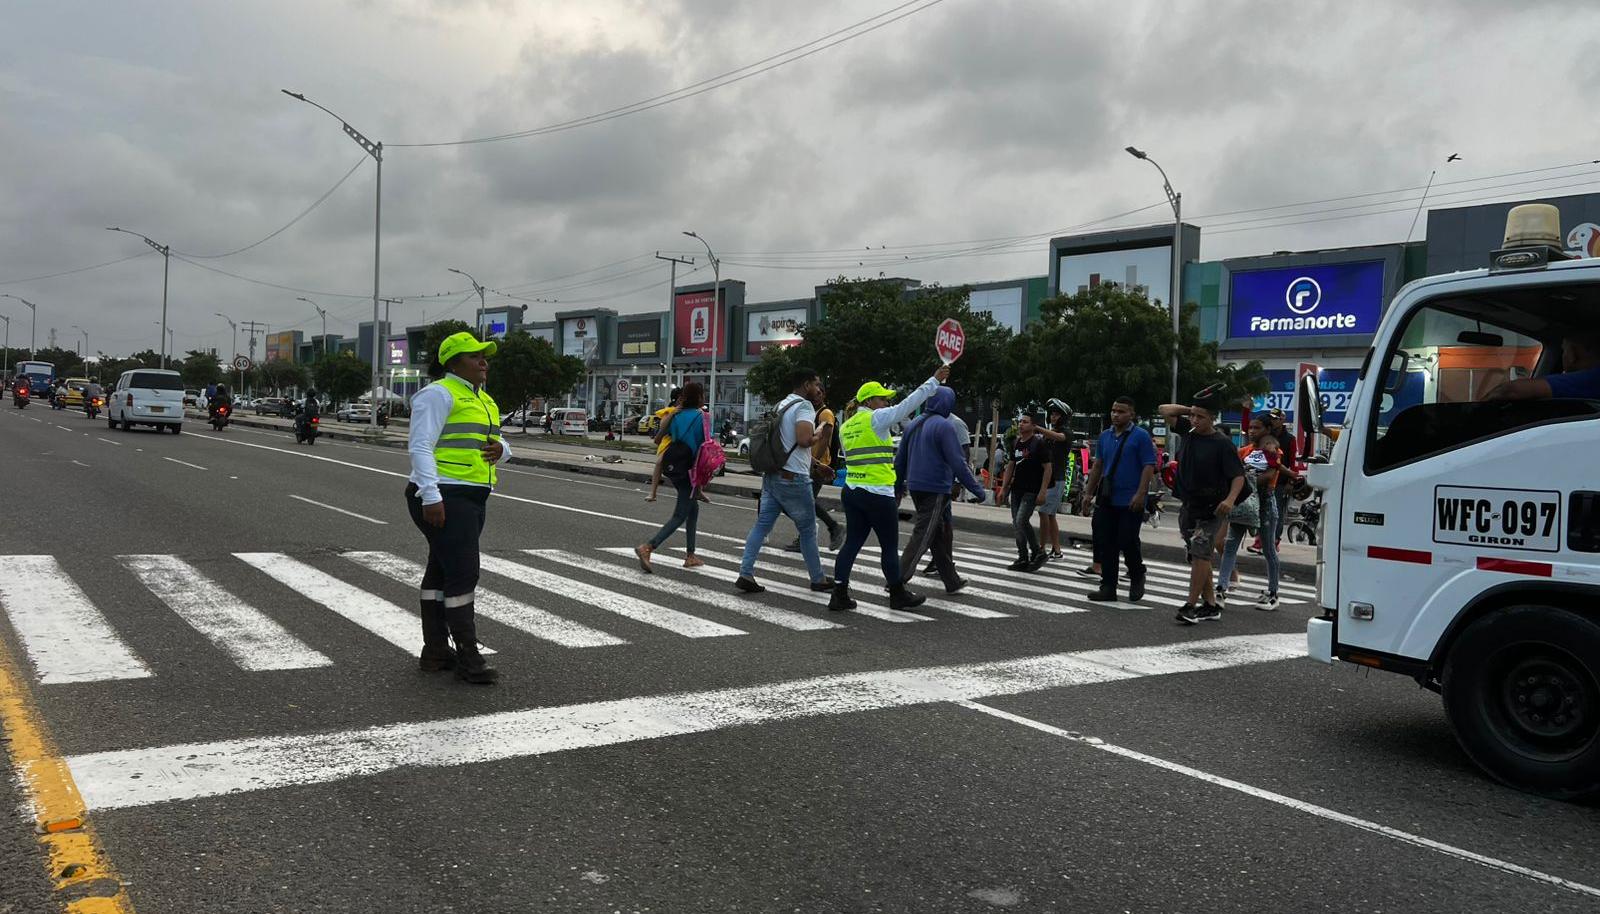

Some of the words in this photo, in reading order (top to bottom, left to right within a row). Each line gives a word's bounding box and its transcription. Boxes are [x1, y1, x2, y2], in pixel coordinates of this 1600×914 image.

[1250, 312, 1357, 332] Farmanorte
[939, 330, 962, 352] PARE
[237, 359, 248, 367] 60
[1266, 393, 1294, 410] 317
[1355, 516, 1382, 525] ISUZU
[1437, 498, 1557, 537] WFC-097
[1468, 535, 1525, 546] GIRON
